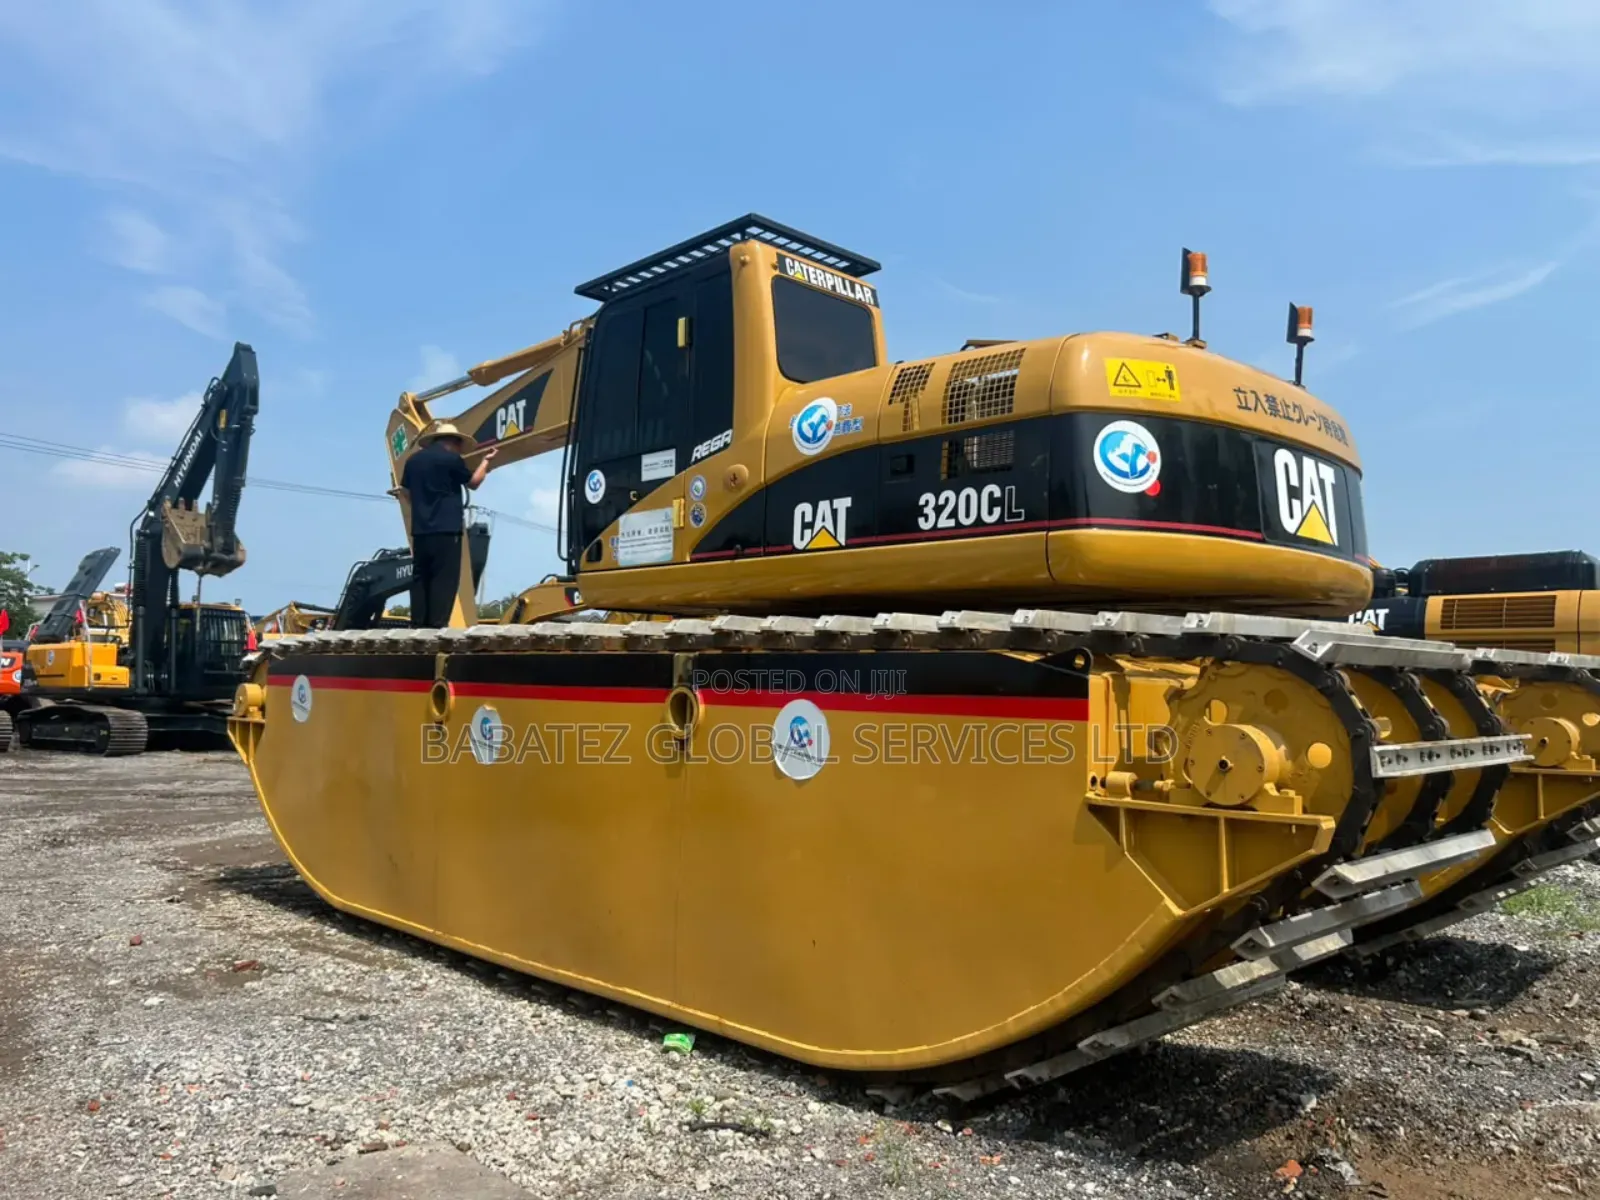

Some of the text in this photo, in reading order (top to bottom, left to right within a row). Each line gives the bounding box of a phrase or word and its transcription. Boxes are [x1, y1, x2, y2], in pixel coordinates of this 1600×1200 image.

[785, 257, 875, 305] CATERPILLAR
[496, 399, 527, 440] CAT
[174, 429, 203, 488] HYUNDAI
[1274, 448, 1339, 546] CAT
[793, 497, 852, 550] CAT
[396, 563, 414, 579] HYU
